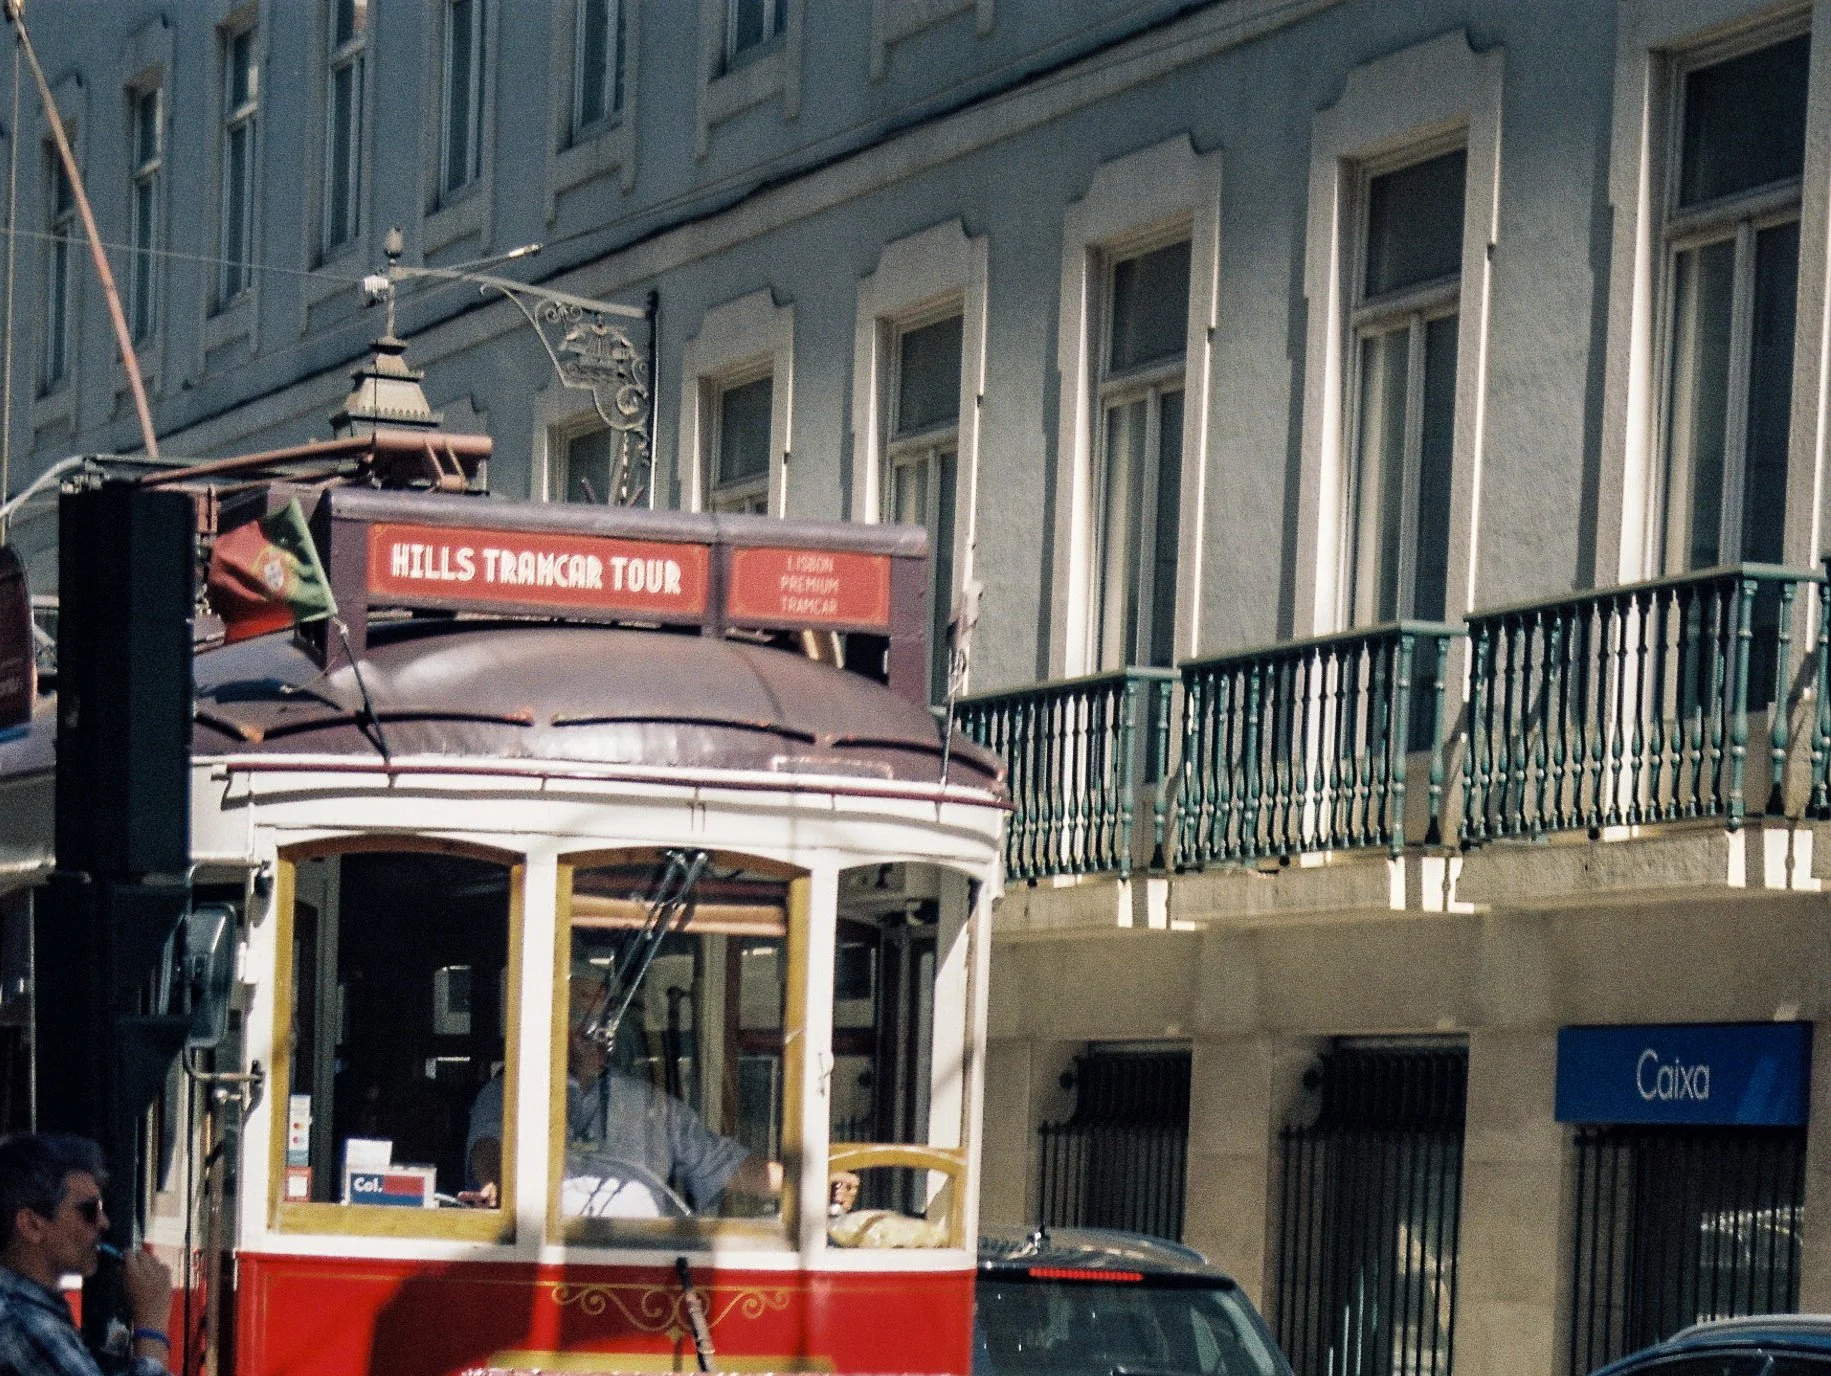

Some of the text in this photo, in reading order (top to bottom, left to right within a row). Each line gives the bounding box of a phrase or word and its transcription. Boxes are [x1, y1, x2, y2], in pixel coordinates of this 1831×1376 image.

[392, 543, 682, 594] HILLS TRAMCAR TOUR
[787, 555, 834, 572] LISBON
[780, 574, 840, 594] PREMIUM
[781, 597, 839, 616] TRAMCAR
[1636, 1048, 1711, 1101] Caixa
[353, 1177, 384, 1194] Col.
